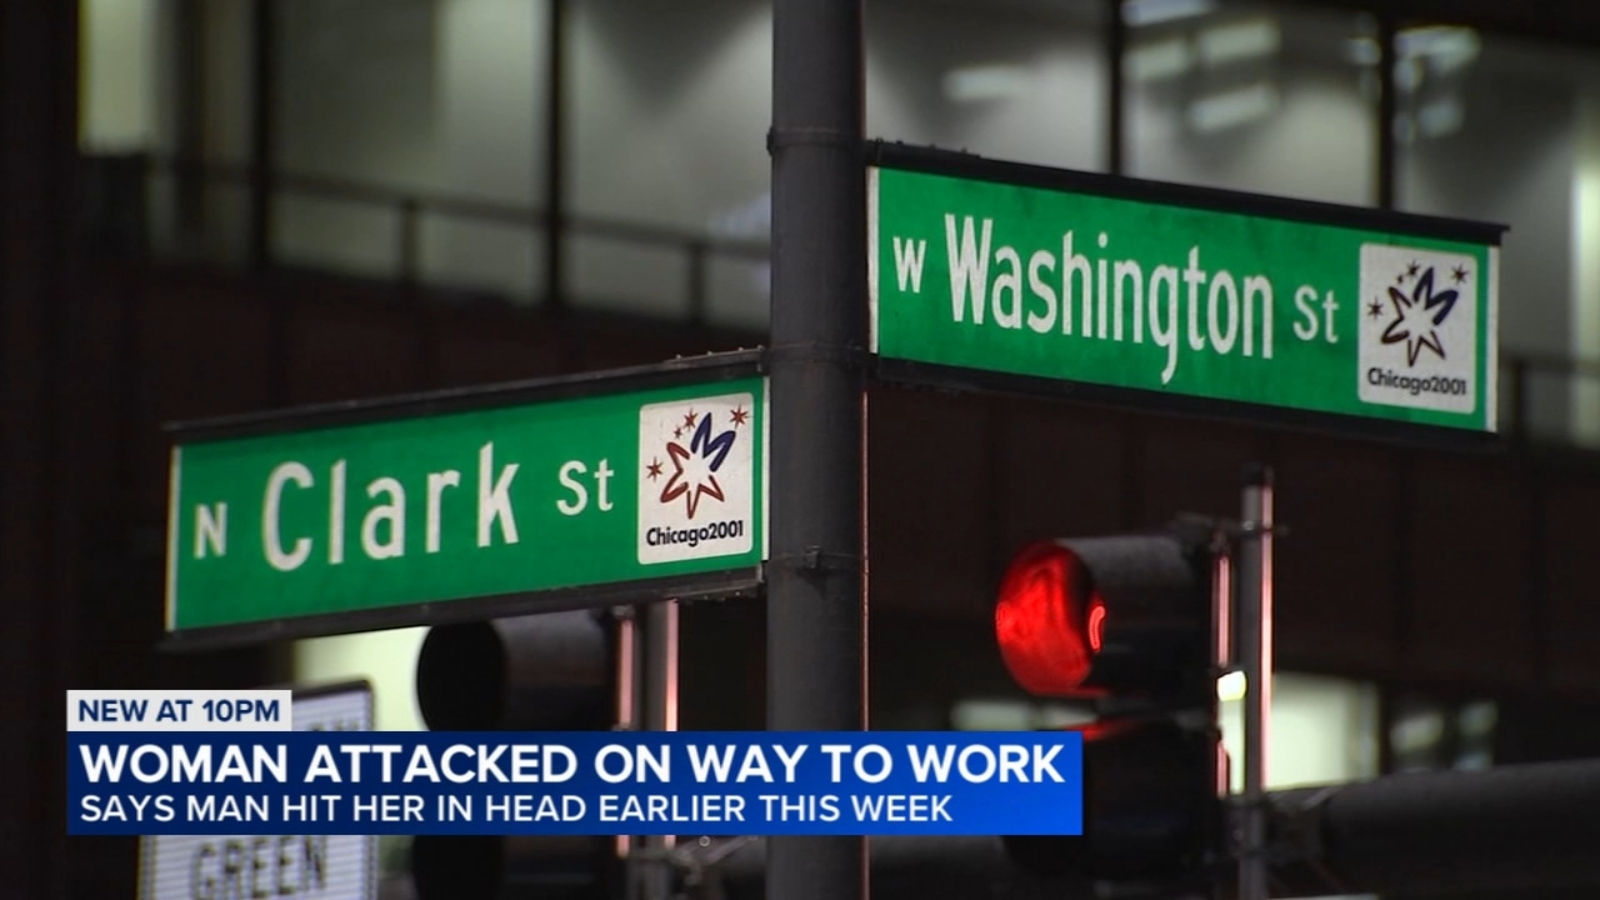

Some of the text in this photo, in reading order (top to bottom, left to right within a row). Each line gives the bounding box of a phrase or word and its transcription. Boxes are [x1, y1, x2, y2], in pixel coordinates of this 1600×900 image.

[893, 213, 1339, 385] W Washington St
[1367, 366, 1467, 396] Chicago2001
[194, 441, 614, 571] N Clark St
[646, 520, 743, 548] Chicago2001
[190, 835, 328, 900] GREEN
